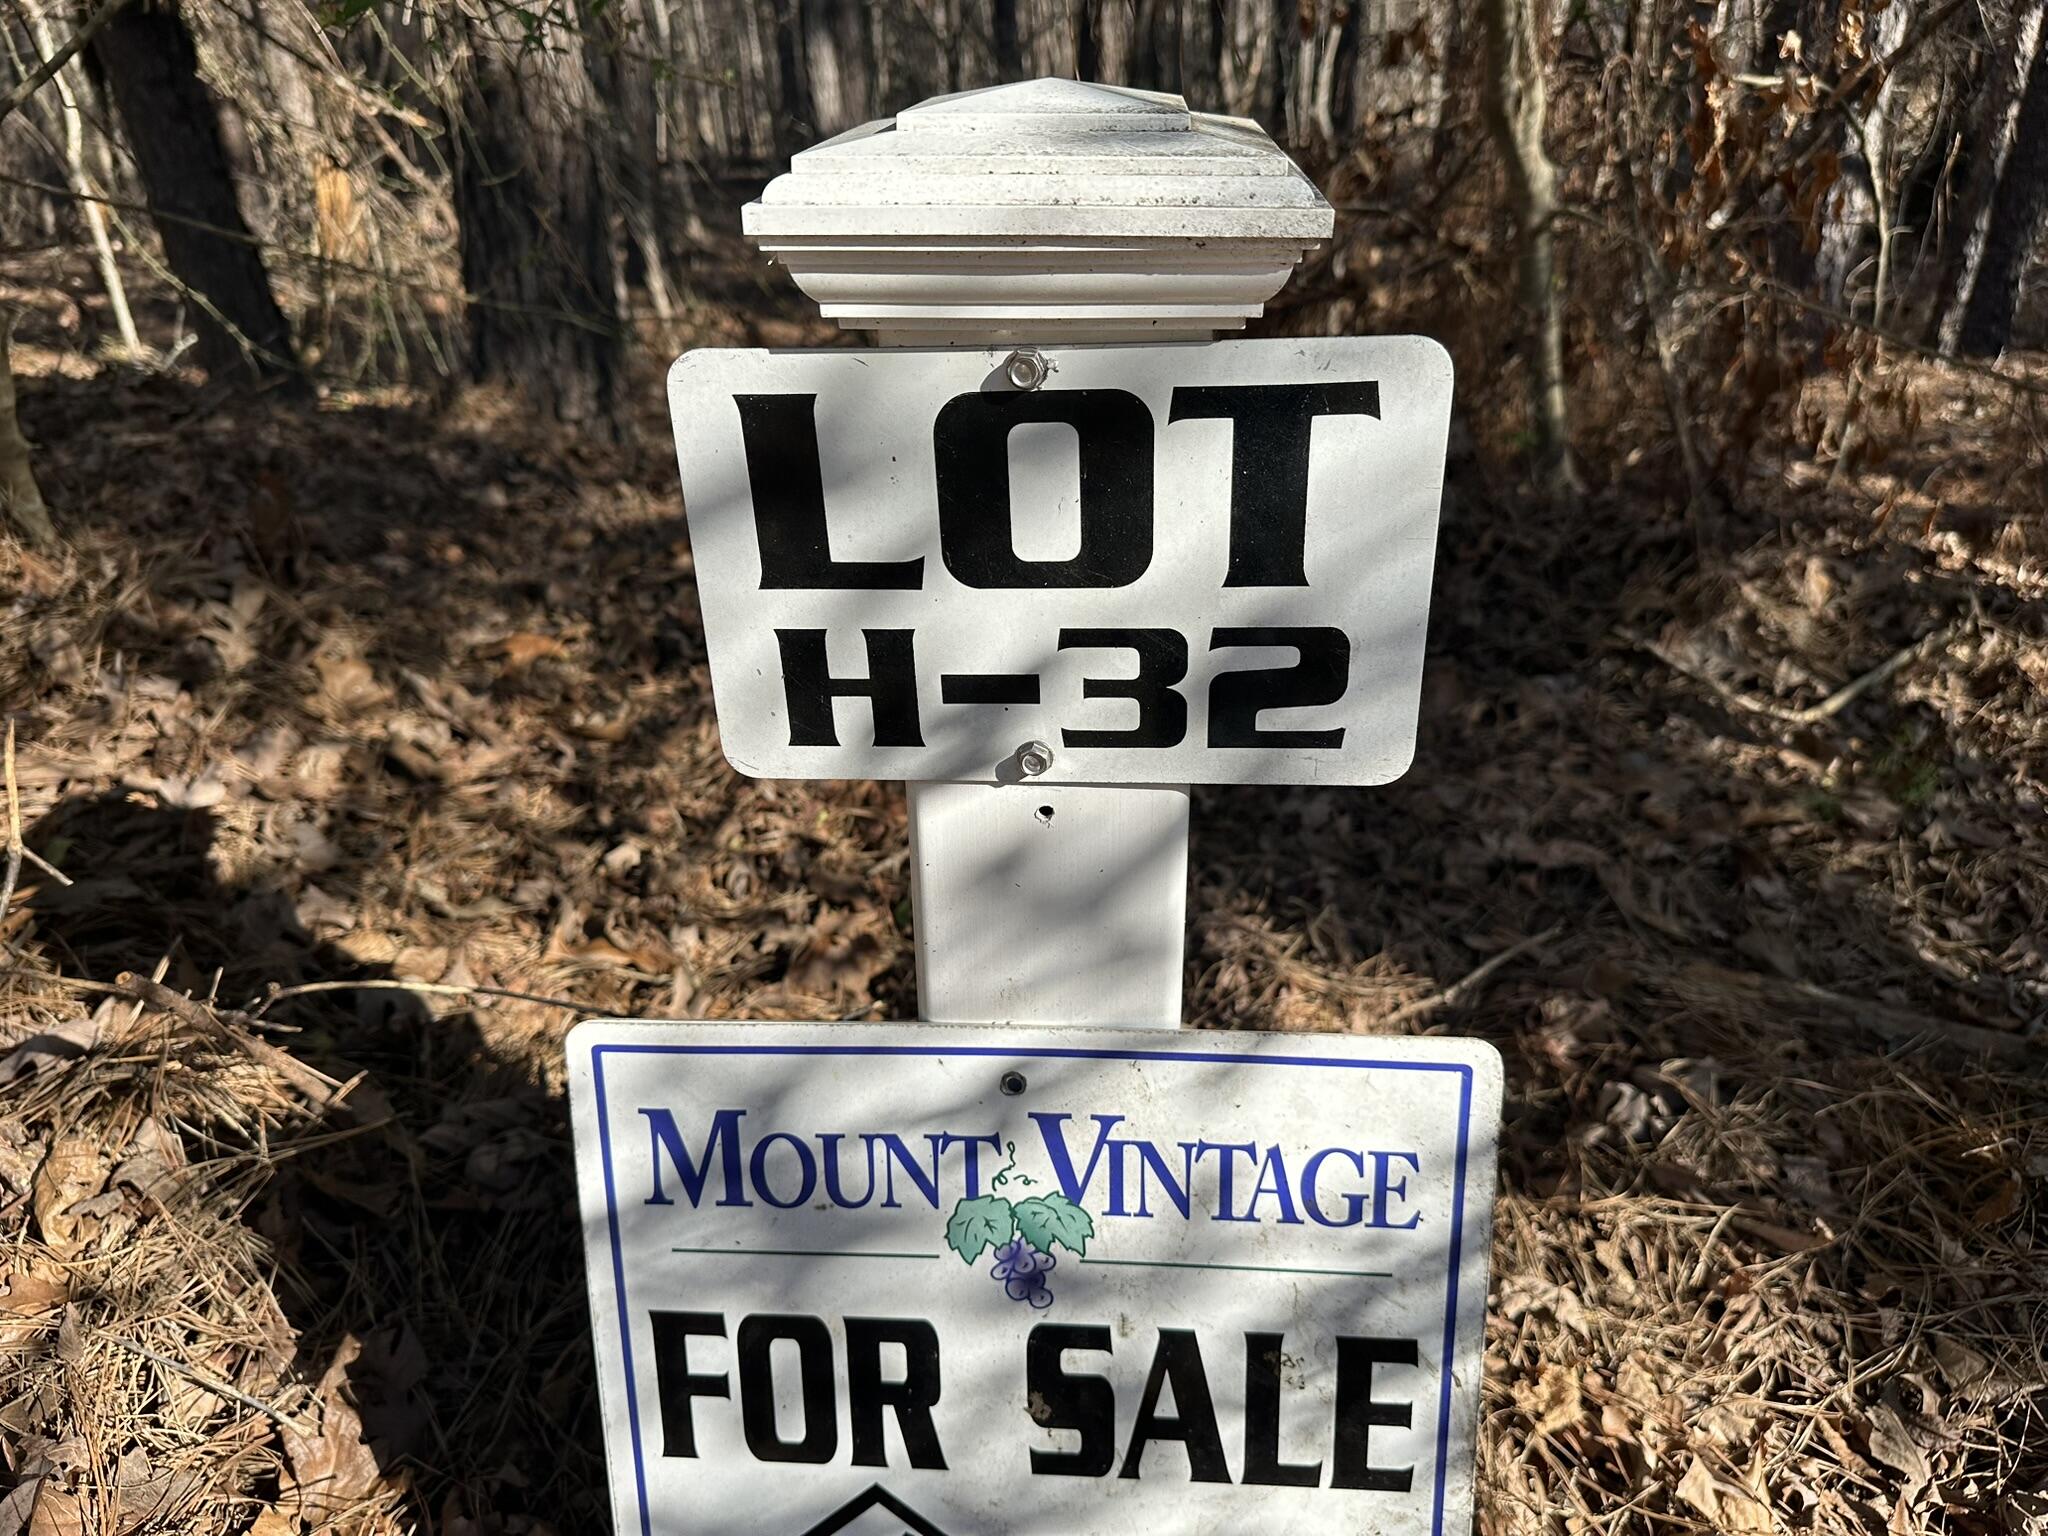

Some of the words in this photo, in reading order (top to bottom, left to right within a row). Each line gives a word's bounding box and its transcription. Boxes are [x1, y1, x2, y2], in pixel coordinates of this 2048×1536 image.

[732, 381, 1381, 590] LOT
[774, 626, 1351, 749] H-32
[638, 1108, 1001, 1210] MOUNT
[1028, 1112, 1420, 1231] VINTAGE
[648, 1310, 948, 1472] FOR
[1026, 1323, 1419, 1493] SALE
